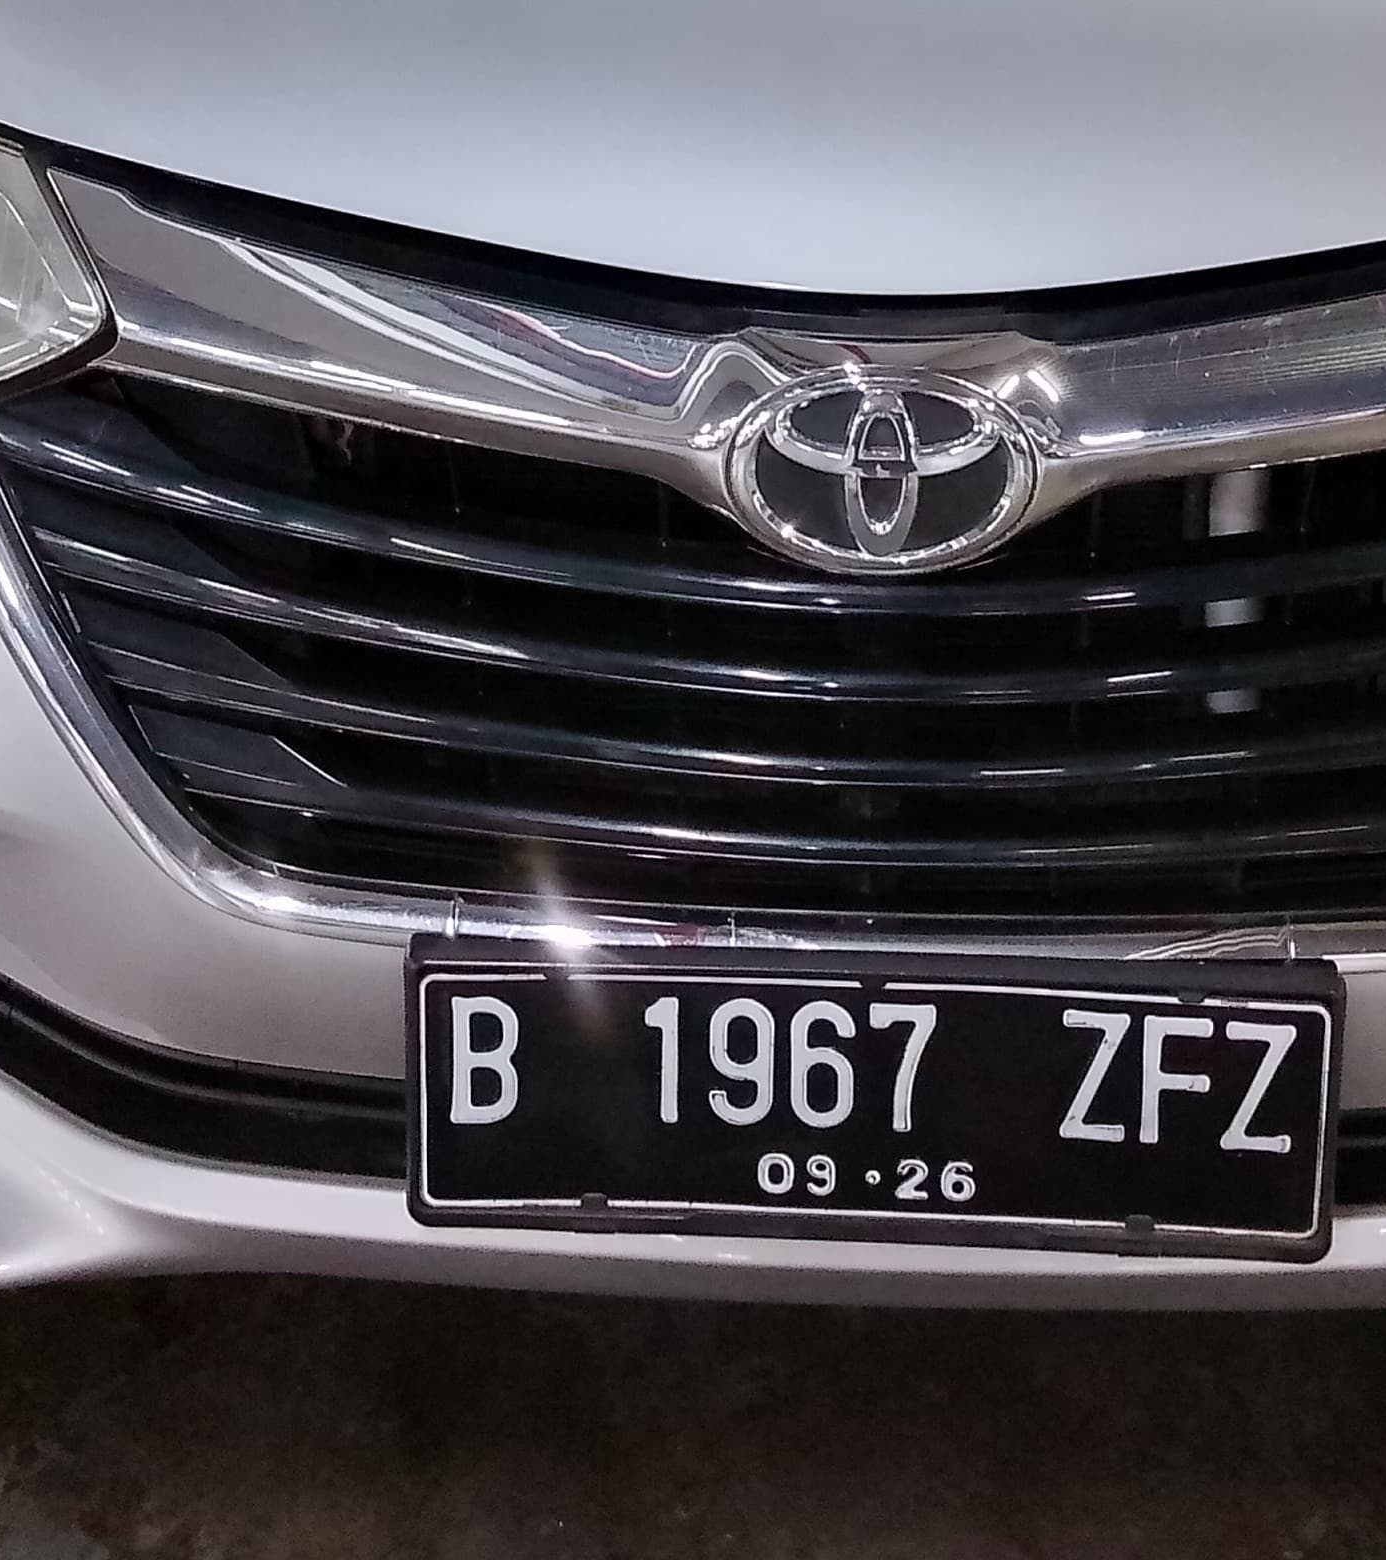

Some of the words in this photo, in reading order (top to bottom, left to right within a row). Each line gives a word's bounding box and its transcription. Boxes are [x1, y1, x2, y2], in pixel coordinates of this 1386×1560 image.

[450, 996, 519, 1124] B
[644, 997, 938, 1132] 1967
[1058, 1007, 1298, 1153] ZFZ
